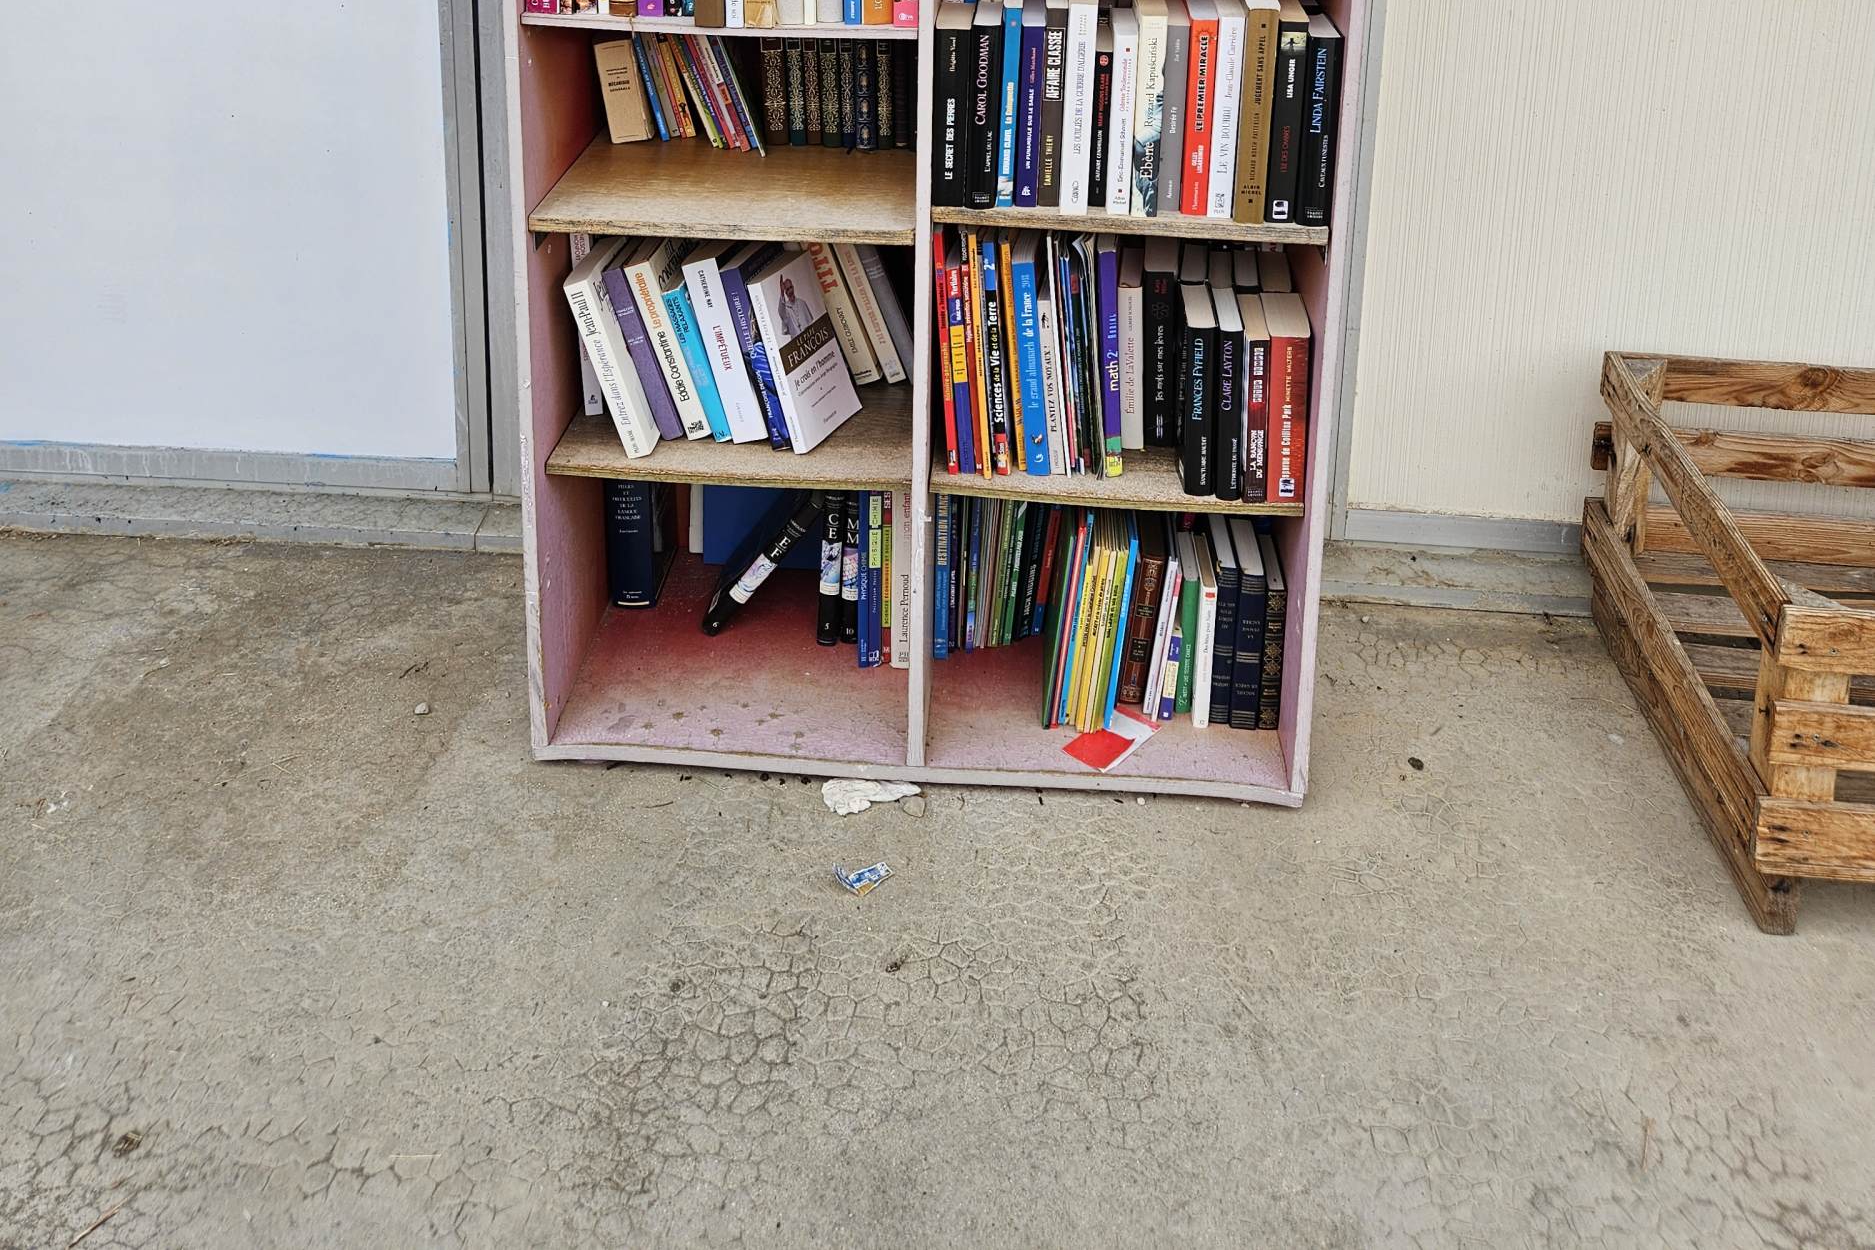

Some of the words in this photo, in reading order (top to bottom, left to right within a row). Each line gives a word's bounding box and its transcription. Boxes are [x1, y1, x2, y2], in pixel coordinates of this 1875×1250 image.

[1047, 31, 1062, 65] CLASSÉE
[1199, 36, 1208, 76] MIRACLE
[1257, 35, 1266, 54] APPEL
[976, 35, 990, 88] GOODMAN
[1146, 38, 1158, 90] Kapuściński
[1256, 56, 1264, 72] SANS
[1287, 59, 1296, 82] UNGER
[1313, 48, 1328, 100] FAIRSTEIN
[1047, 67, 1061, 99] AFFAIRE
[1196, 79, 1205, 119] PREMIER
[1254, 74, 1263, 105] JUGEMENT
[1286, 84, 1295, 98] LISA
[946, 98, 956, 125] PIERRES
[975, 90, 986, 125] CAROL
[1144, 93, 1156, 128] Ryszard
[1309, 103, 1323, 133] LINDA
[946, 128, 955, 141] DES
[1195, 121, 1203, 131] LE
[945, 144, 954, 168] SECRET
[1139, 142, 1155, 179] Ebène
[944, 170, 953, 180] LE
[635, 271, 661, 317] propriétaire
[651, 315, 664, 329] Le
[987, 301, 997, 326] Terre
[713, 325, 733, 371] L'IMPÉTUEUX
[787, 326, 829, 368] FRANÇOIS
[989, 333, 998, 342] de
[656, 330, 682, 380] Constantine
[989, 350, 1000, 366] Vie
[1044, 350, 1052, 381] NOYAUX
[1193, 338, 1204, 376] FYFIELD
[1222, 340, 1233, 377] LAYTON
[1046, 382, 1054, 397] VOS
[1104, 361, 1119, 391] math
[992, 382, 1004, 423] Sciences
[1191, 378, 1203, 420] FRANCES
[1221, 379, 1232, 411] CLARE
[1047, 399, 1057, 433] PLANTEZ
[937, 519, 948, 565] DESTINATION
[898, 574, 909, 606] Pernoud
[1026, 564, 1037, 595] HIGGINS
[1024, 596, 1032, 615] JACK
[898, 607, 909, 643] Laurence
